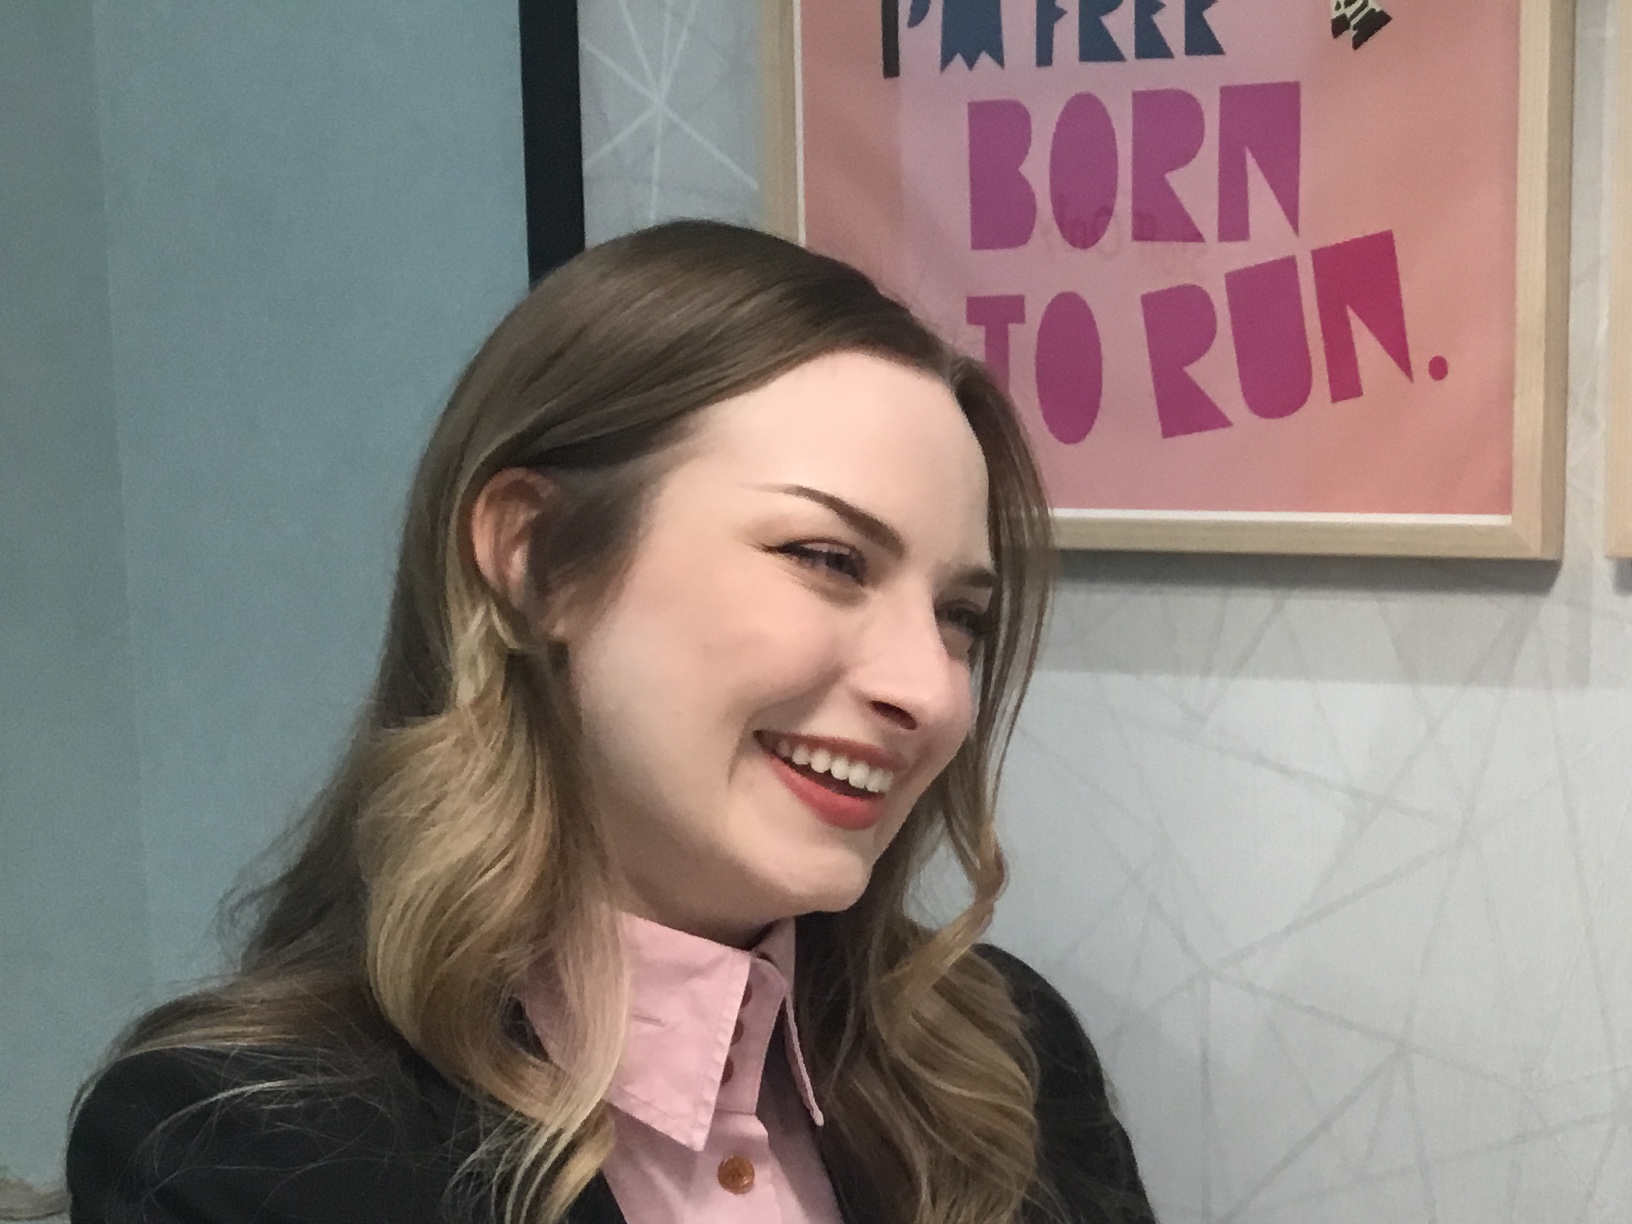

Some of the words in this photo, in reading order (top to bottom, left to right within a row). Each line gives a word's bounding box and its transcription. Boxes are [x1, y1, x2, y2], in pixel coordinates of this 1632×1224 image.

[967, 81, 1301, 251] BORN
[966, 290, 1102, 445] TO
[1141, 229, 1449, 439] RUN.
